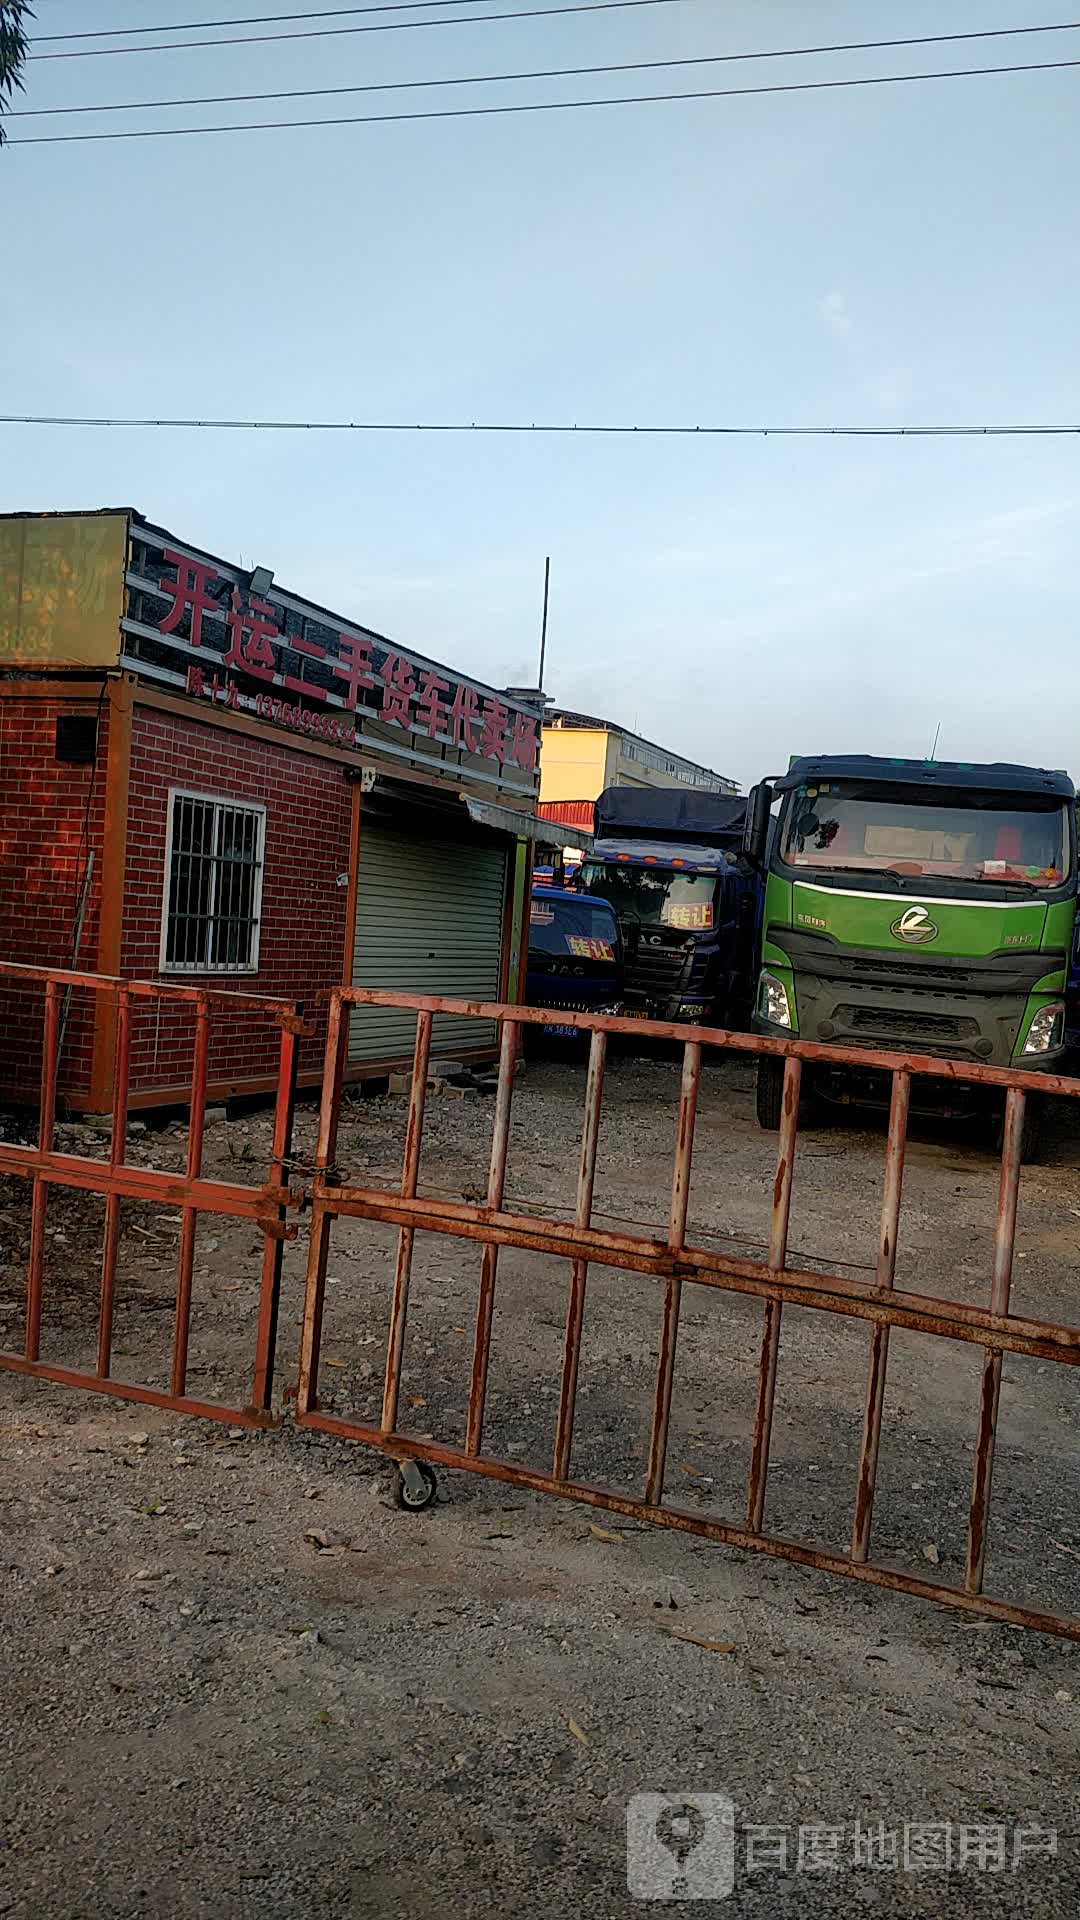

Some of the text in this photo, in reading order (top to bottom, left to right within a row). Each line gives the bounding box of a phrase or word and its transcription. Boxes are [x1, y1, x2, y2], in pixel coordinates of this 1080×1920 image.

[159, 548, 537, 772] 开运二手货车代卖场
[669, 905, 711, 928] 转让
[568, 937, 613, 961] 转让
[547, 964, 585, 976] JAC
